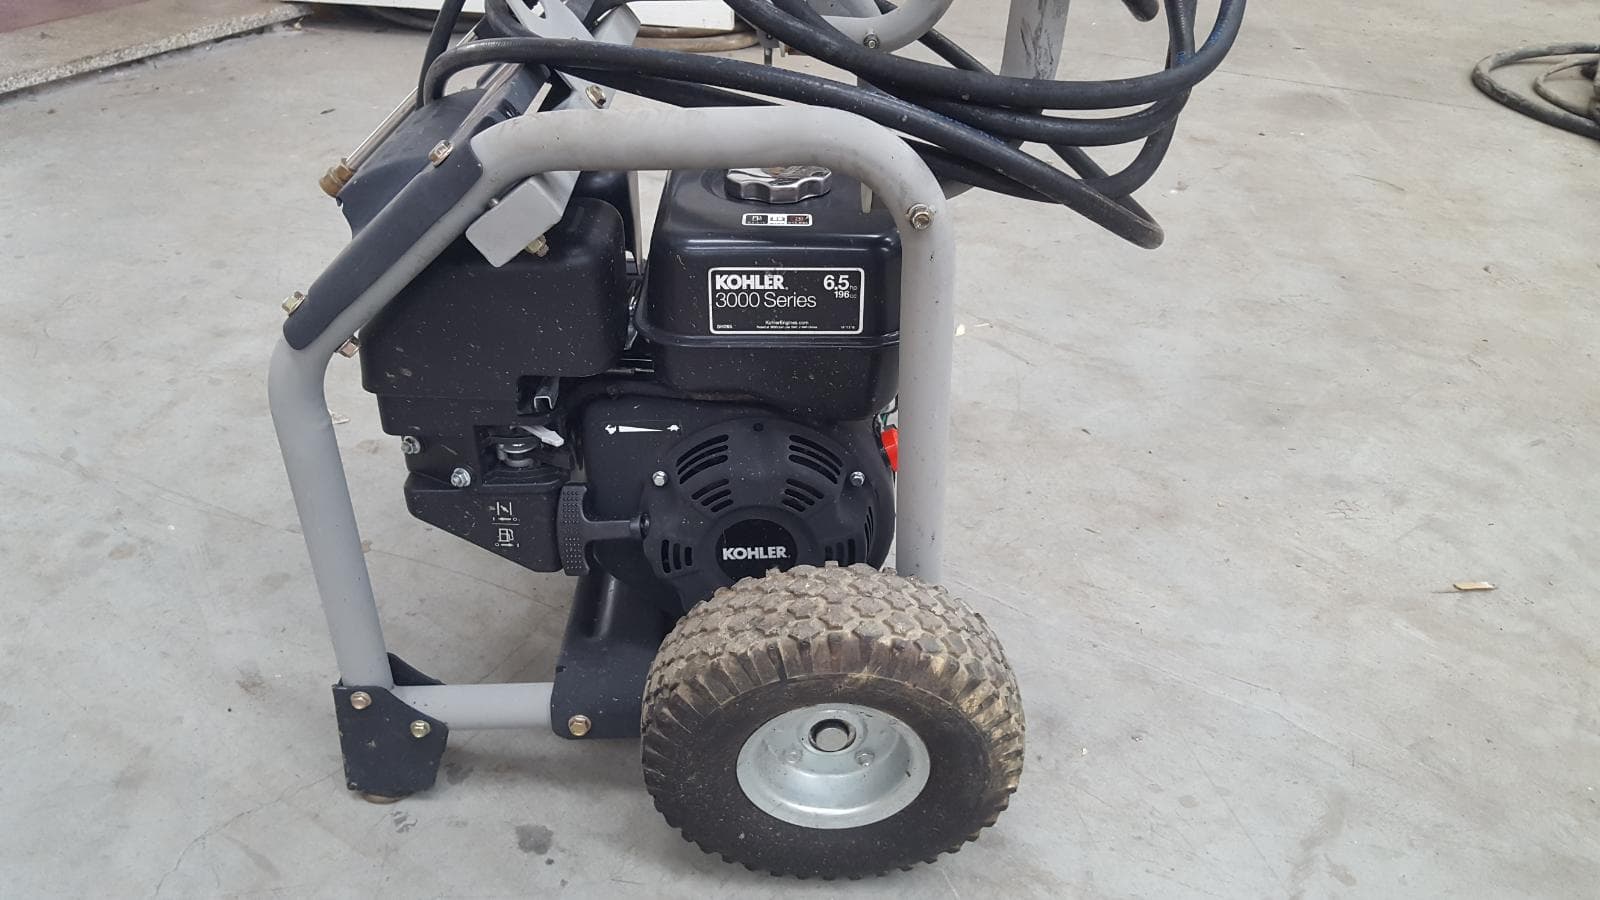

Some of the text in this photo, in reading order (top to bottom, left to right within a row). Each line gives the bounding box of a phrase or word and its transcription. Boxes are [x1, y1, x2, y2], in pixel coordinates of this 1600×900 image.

[715, 274, 785, 290] KOHLER
[823, 274, 850, 291] 6.5
[715, 291, 817, 308] 3000 Series
[834, 290, 850, 299] 196
[722, 546, 788, 561] KOHLER
